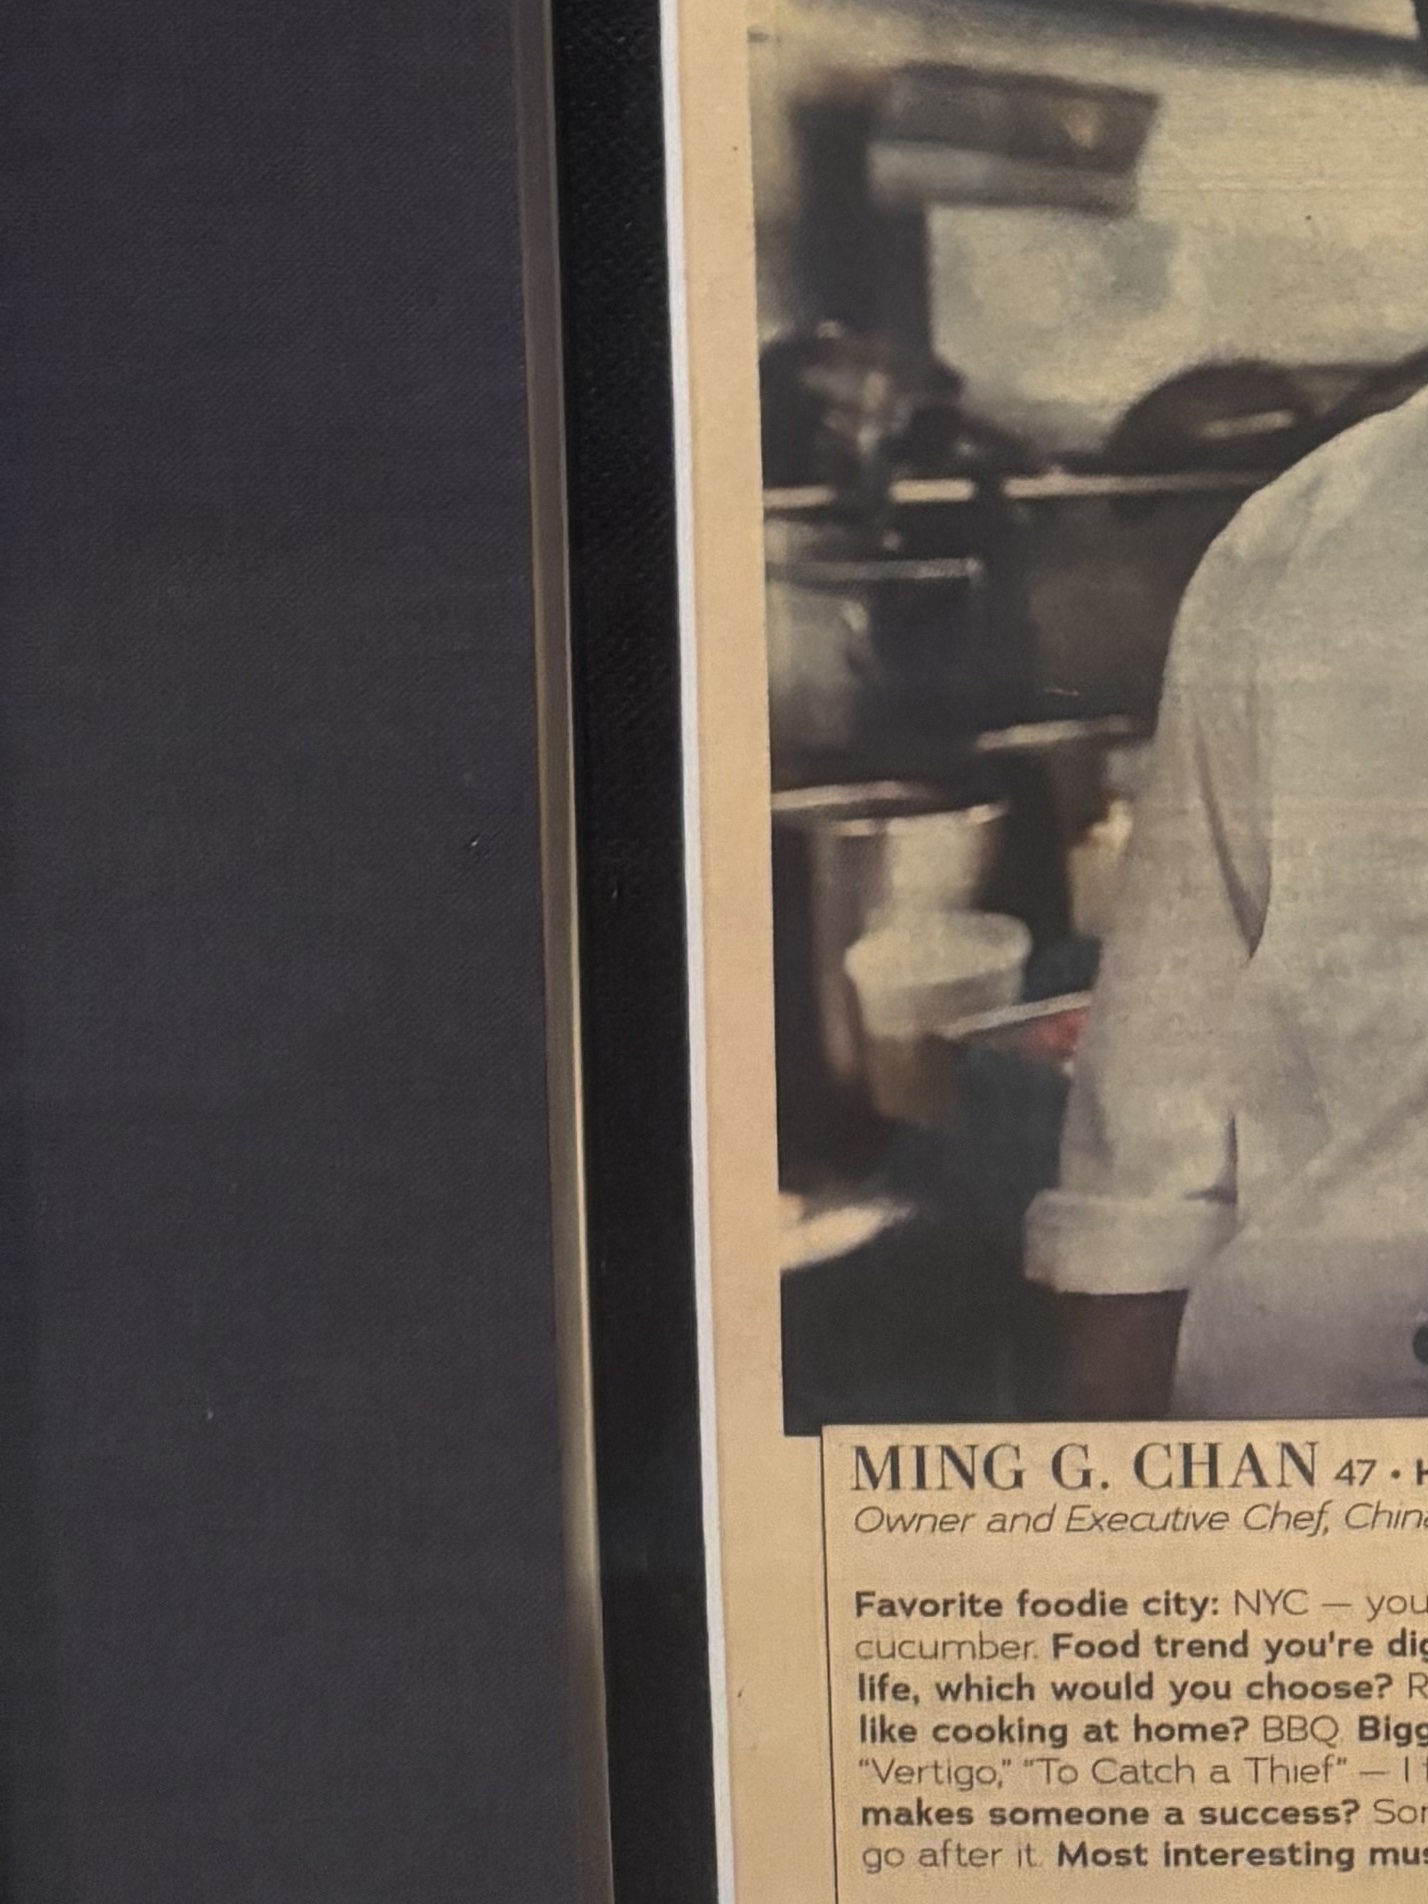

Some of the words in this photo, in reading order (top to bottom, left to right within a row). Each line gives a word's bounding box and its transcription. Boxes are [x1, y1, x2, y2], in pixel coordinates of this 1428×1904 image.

[850, 1441, 1026, 1492] MING
[1050, 1442, 1110, 1492] G.
[1132, 1440, 1320, 1491] CHAN
[1332, 1458, 1378, 1488] 47
[853, 1504, 978, 1535] Owner
[985, 1501, 1058, 1535] and
[1064, 1503, 1231, 1534] Executive
[1242, 1498, 1334, 1539] Chef,
[854, 1590, 1004, 1619] Favorite
[1016, 1587, 1129, 1618] foodie
[1142, 1588, 1220, 1624] city:
[1234, 1588, 1309, 1617] NYC
[861, 1846, 906, 1875] go
[917, 1841, 1004, 1869] after
[1056, 1839, 1149, 1869] Most
[1162, 1839, 1356, 1874] interesting
